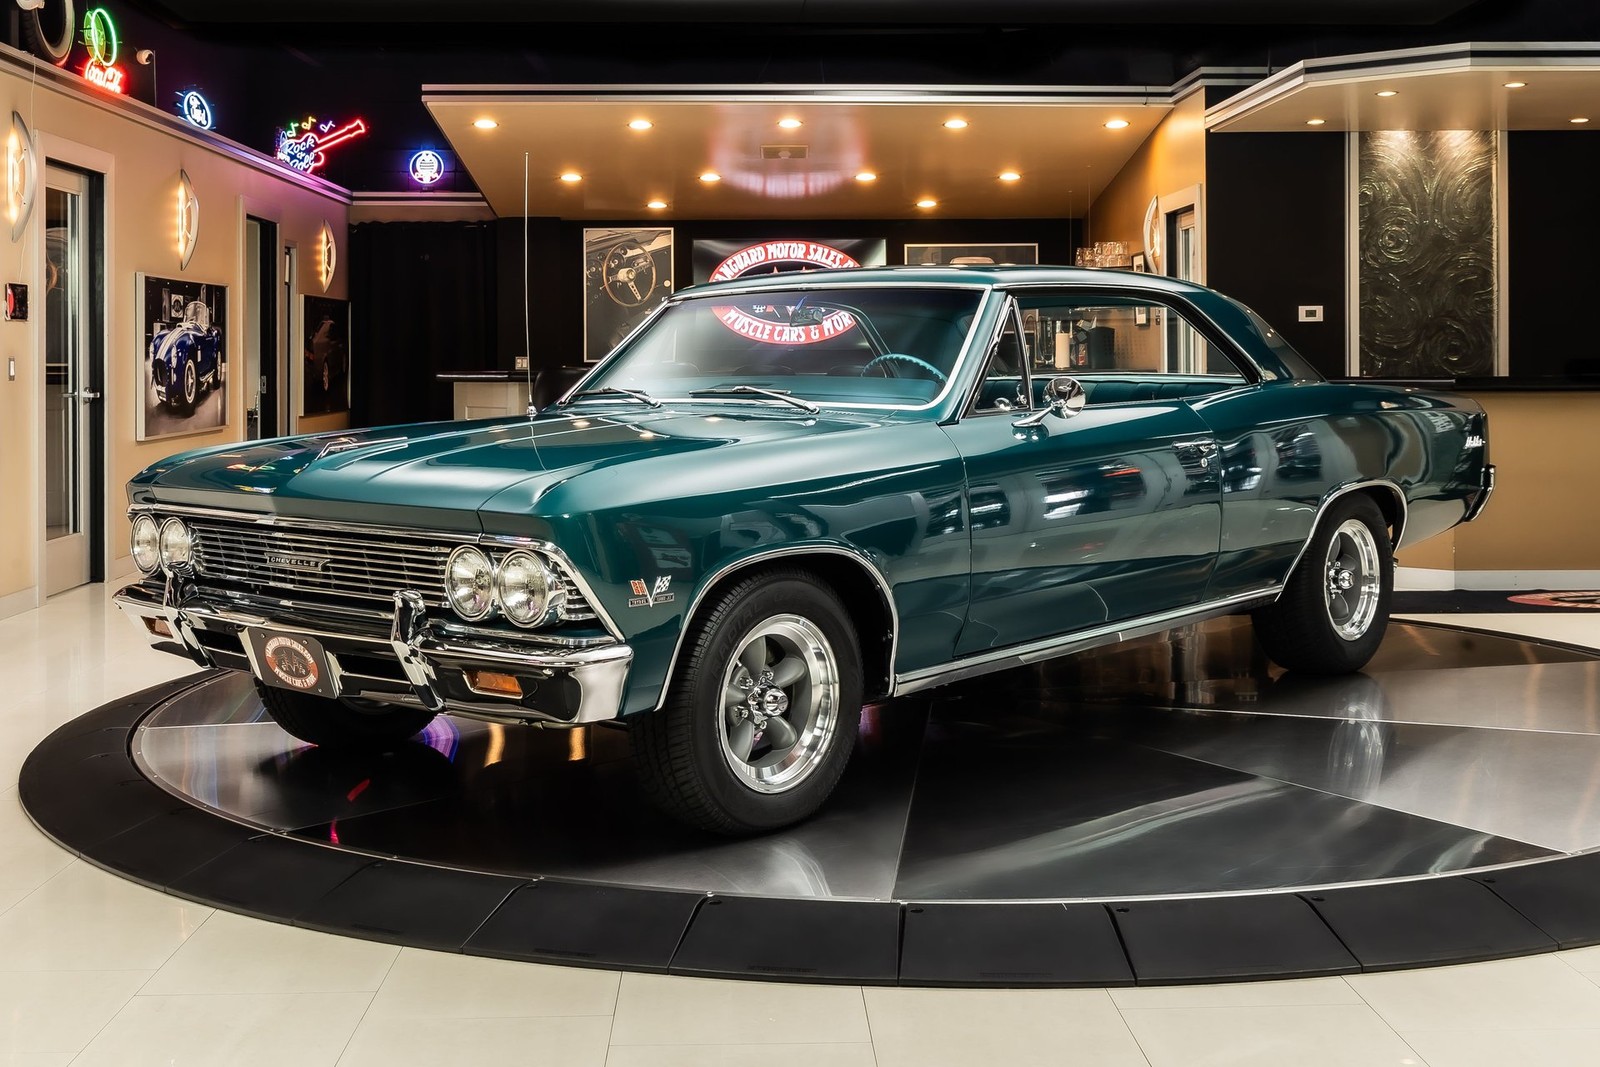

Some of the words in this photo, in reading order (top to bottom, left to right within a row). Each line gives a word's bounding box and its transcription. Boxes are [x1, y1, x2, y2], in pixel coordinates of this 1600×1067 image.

[713, 246, 766, 281] ANGUARD
[766, 242, 807, 260] MOTOR
[723, 309, 773, 340] MUSCLE
[773, 325, 806, 342] CARS
[822, 310, 855, 337] MOR
[270, 557, 316, 567] CHEVELLE
